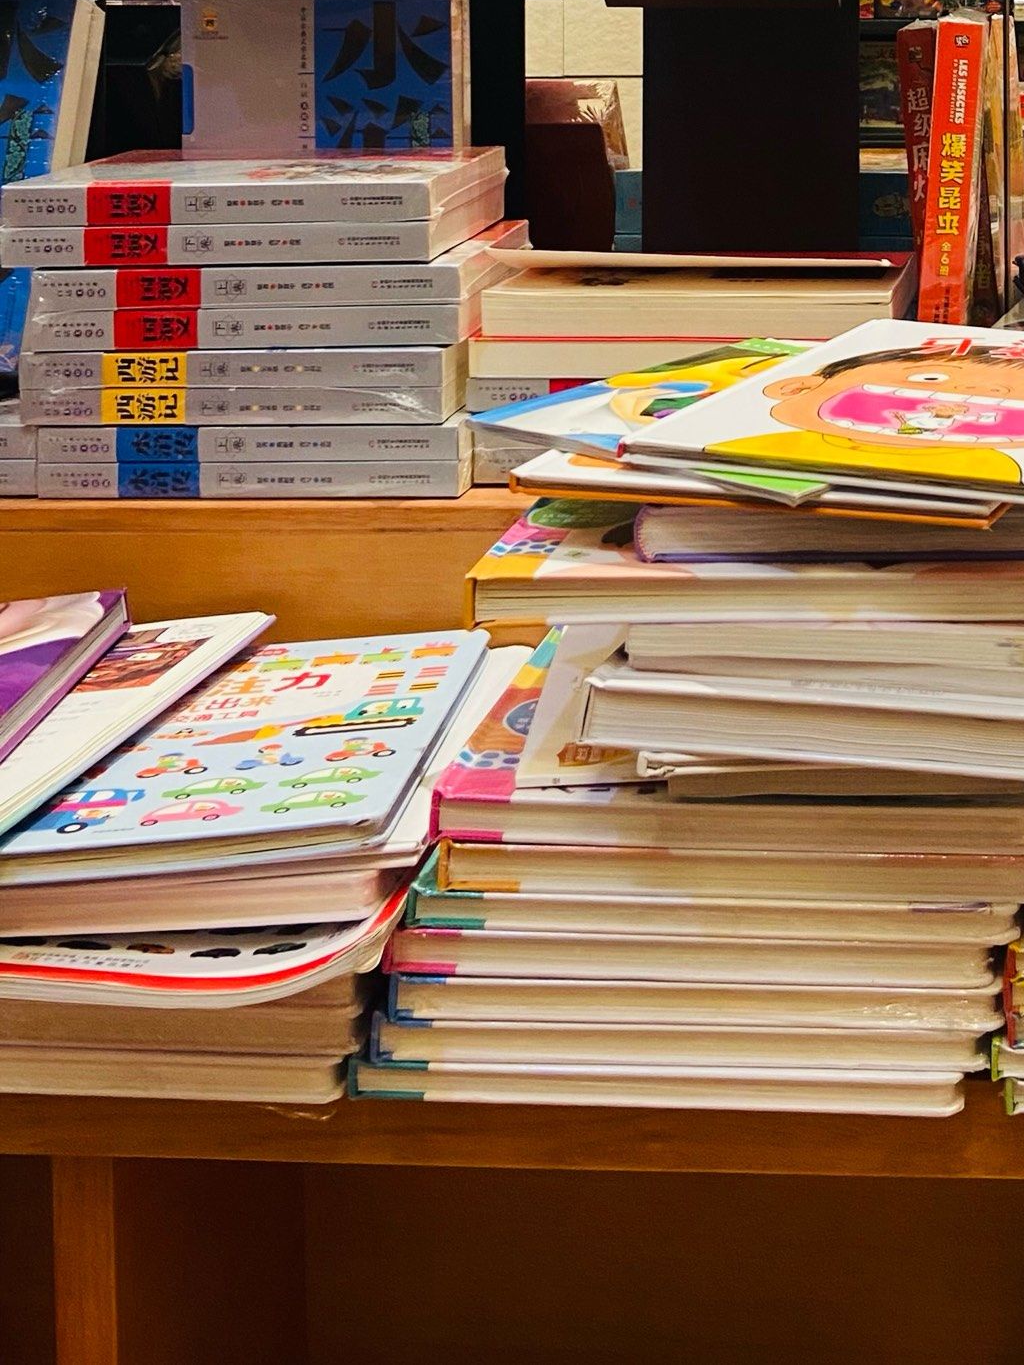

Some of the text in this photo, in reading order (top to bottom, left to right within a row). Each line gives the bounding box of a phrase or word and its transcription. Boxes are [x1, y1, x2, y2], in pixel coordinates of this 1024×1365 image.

[955, 58, 969, 125] LES INSECTES
[936, 133, 967, 236] 爆笑昆虫
[939, 241, 953, 277] 全6册
[115, 356, 179, 383] 西游记
[115, 393, 178, 420] 西游记
